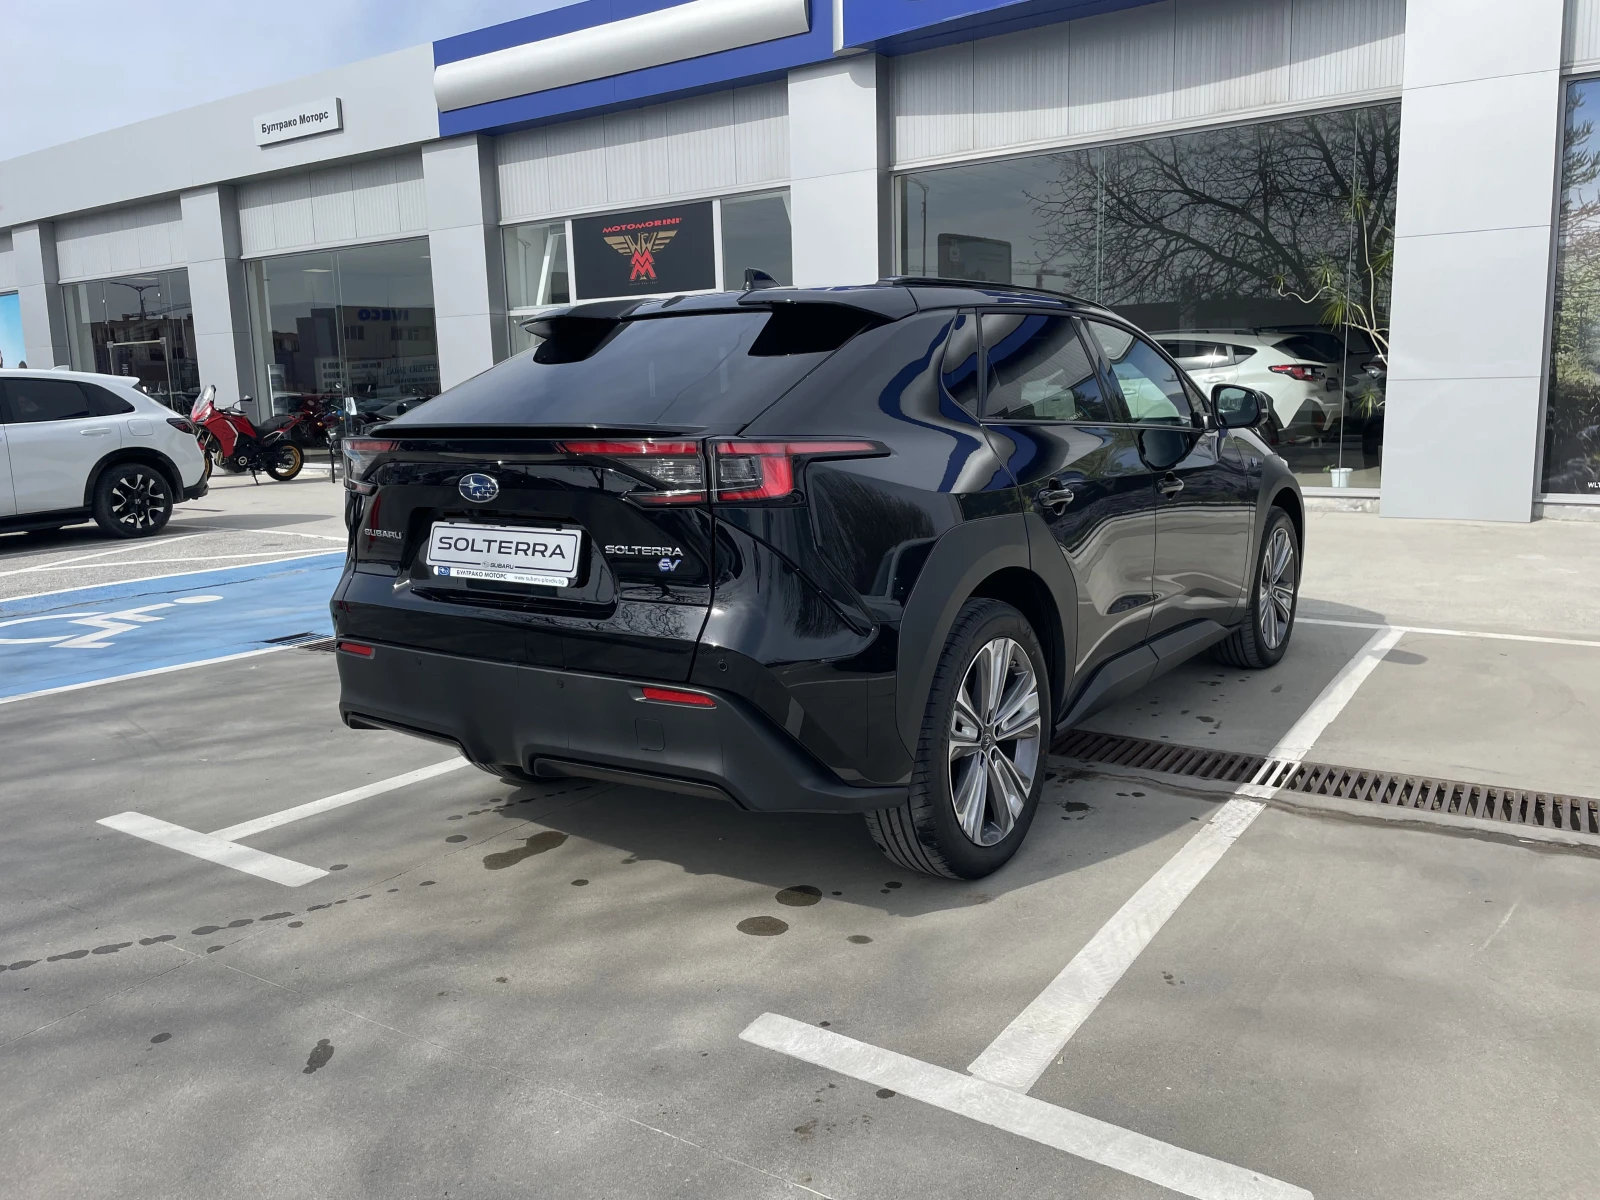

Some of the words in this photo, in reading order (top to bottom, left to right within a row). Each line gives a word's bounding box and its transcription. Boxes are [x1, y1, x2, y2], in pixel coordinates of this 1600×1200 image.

[261, 118, 297, 134] Бултрако
[299, 111, 329, 125] Моторс
[364, 528, 402, 539] SUBARU
[437, 536, 566, 559] SOLTERRA
[604, 544, 684, 556] SOLTERRA
[489, 562, 515, 570] SUBARU
[658, 558, 681, 572] EV
[456, 569, 483, 578] БУЛТРАКО
[484, 571, 507, 580] МОТОРС
